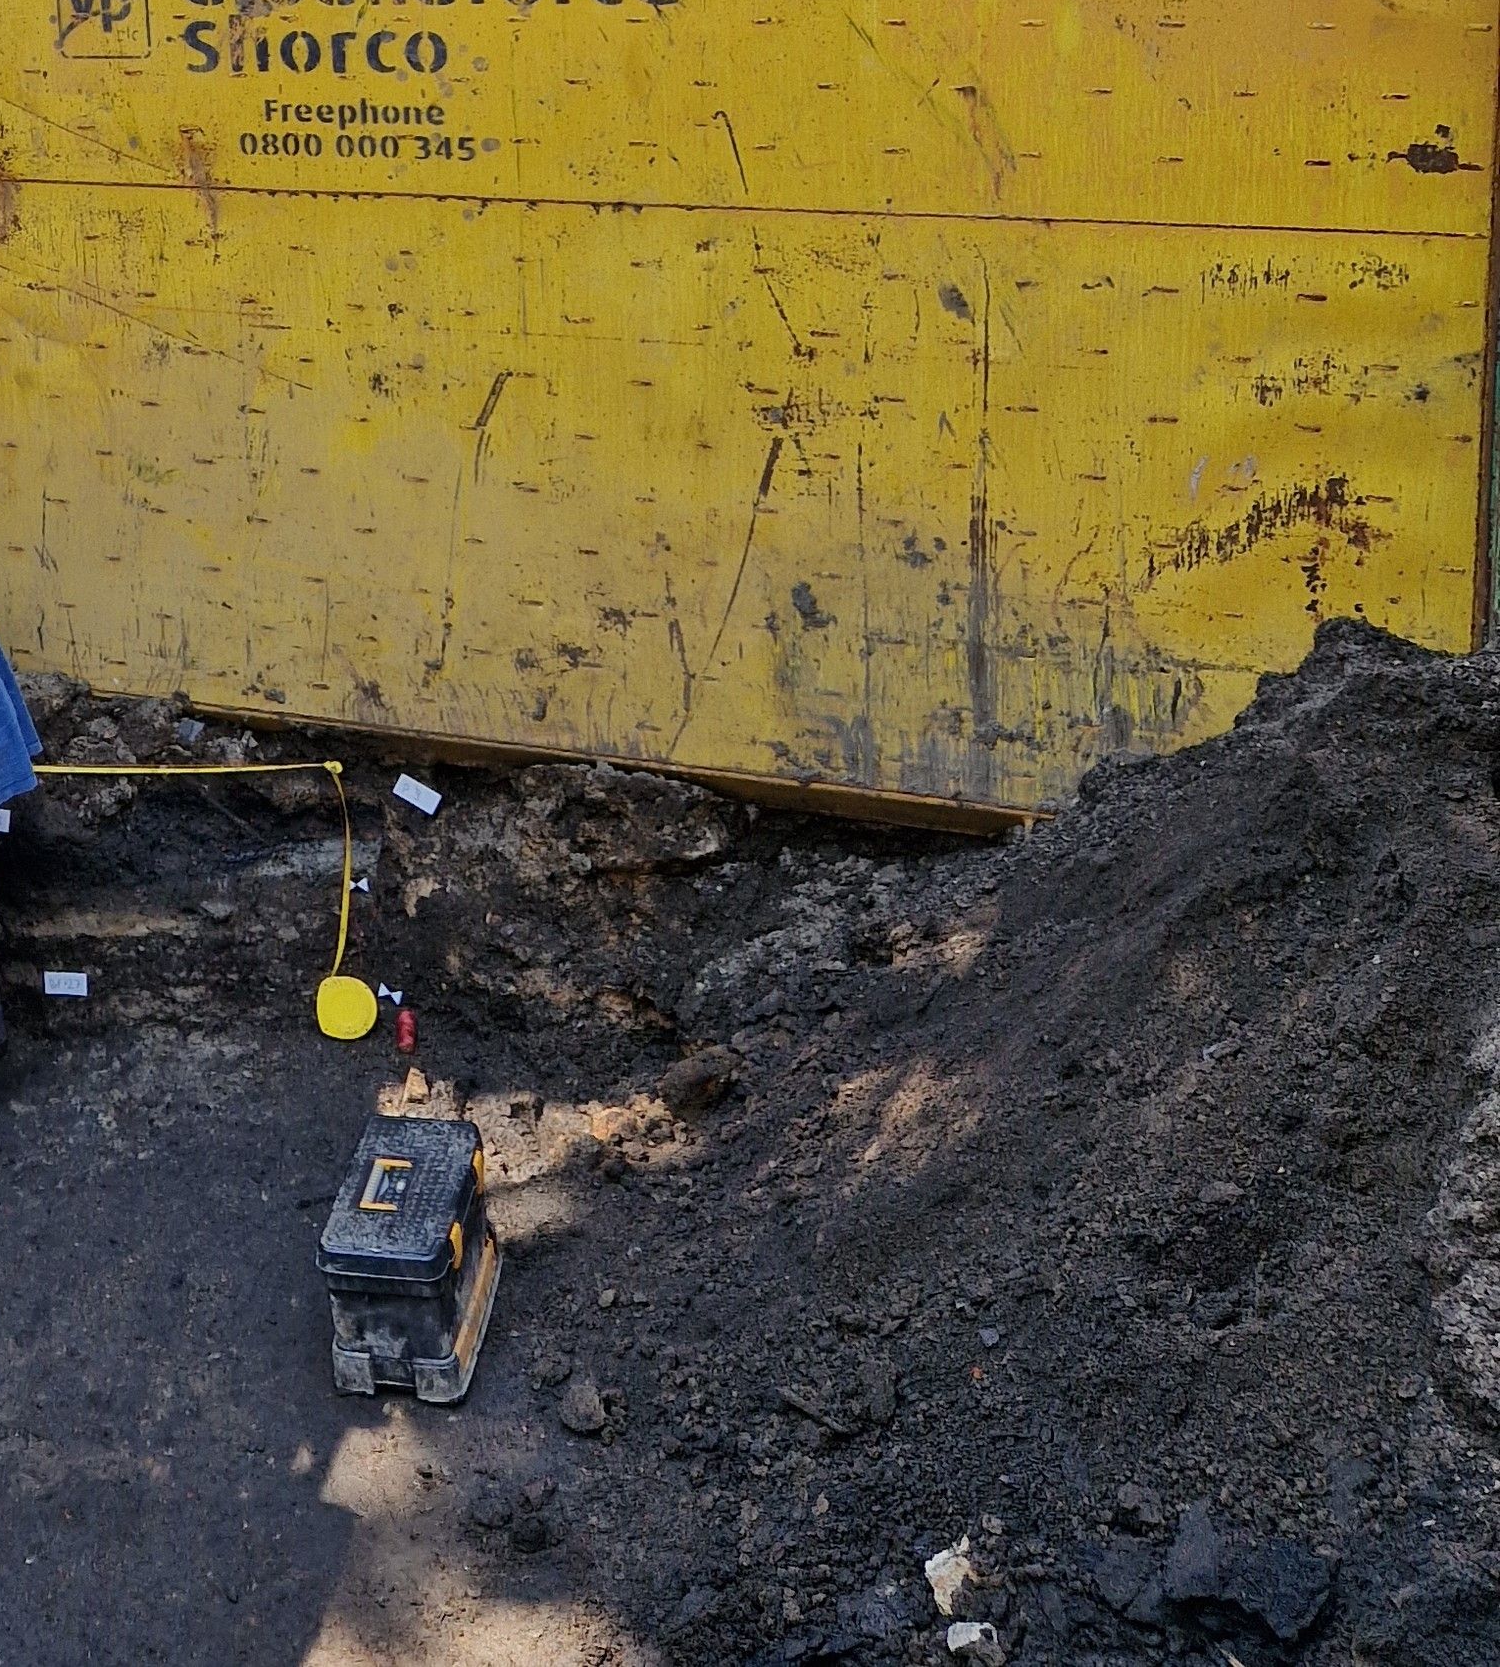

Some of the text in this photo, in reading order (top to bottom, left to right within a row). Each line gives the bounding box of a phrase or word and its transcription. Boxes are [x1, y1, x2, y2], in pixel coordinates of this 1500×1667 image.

[183, 13, 450, 76] Shorco
[263, 98, 446, 129] Freephone
[239, 131, 478, 163] 0800 000 345
